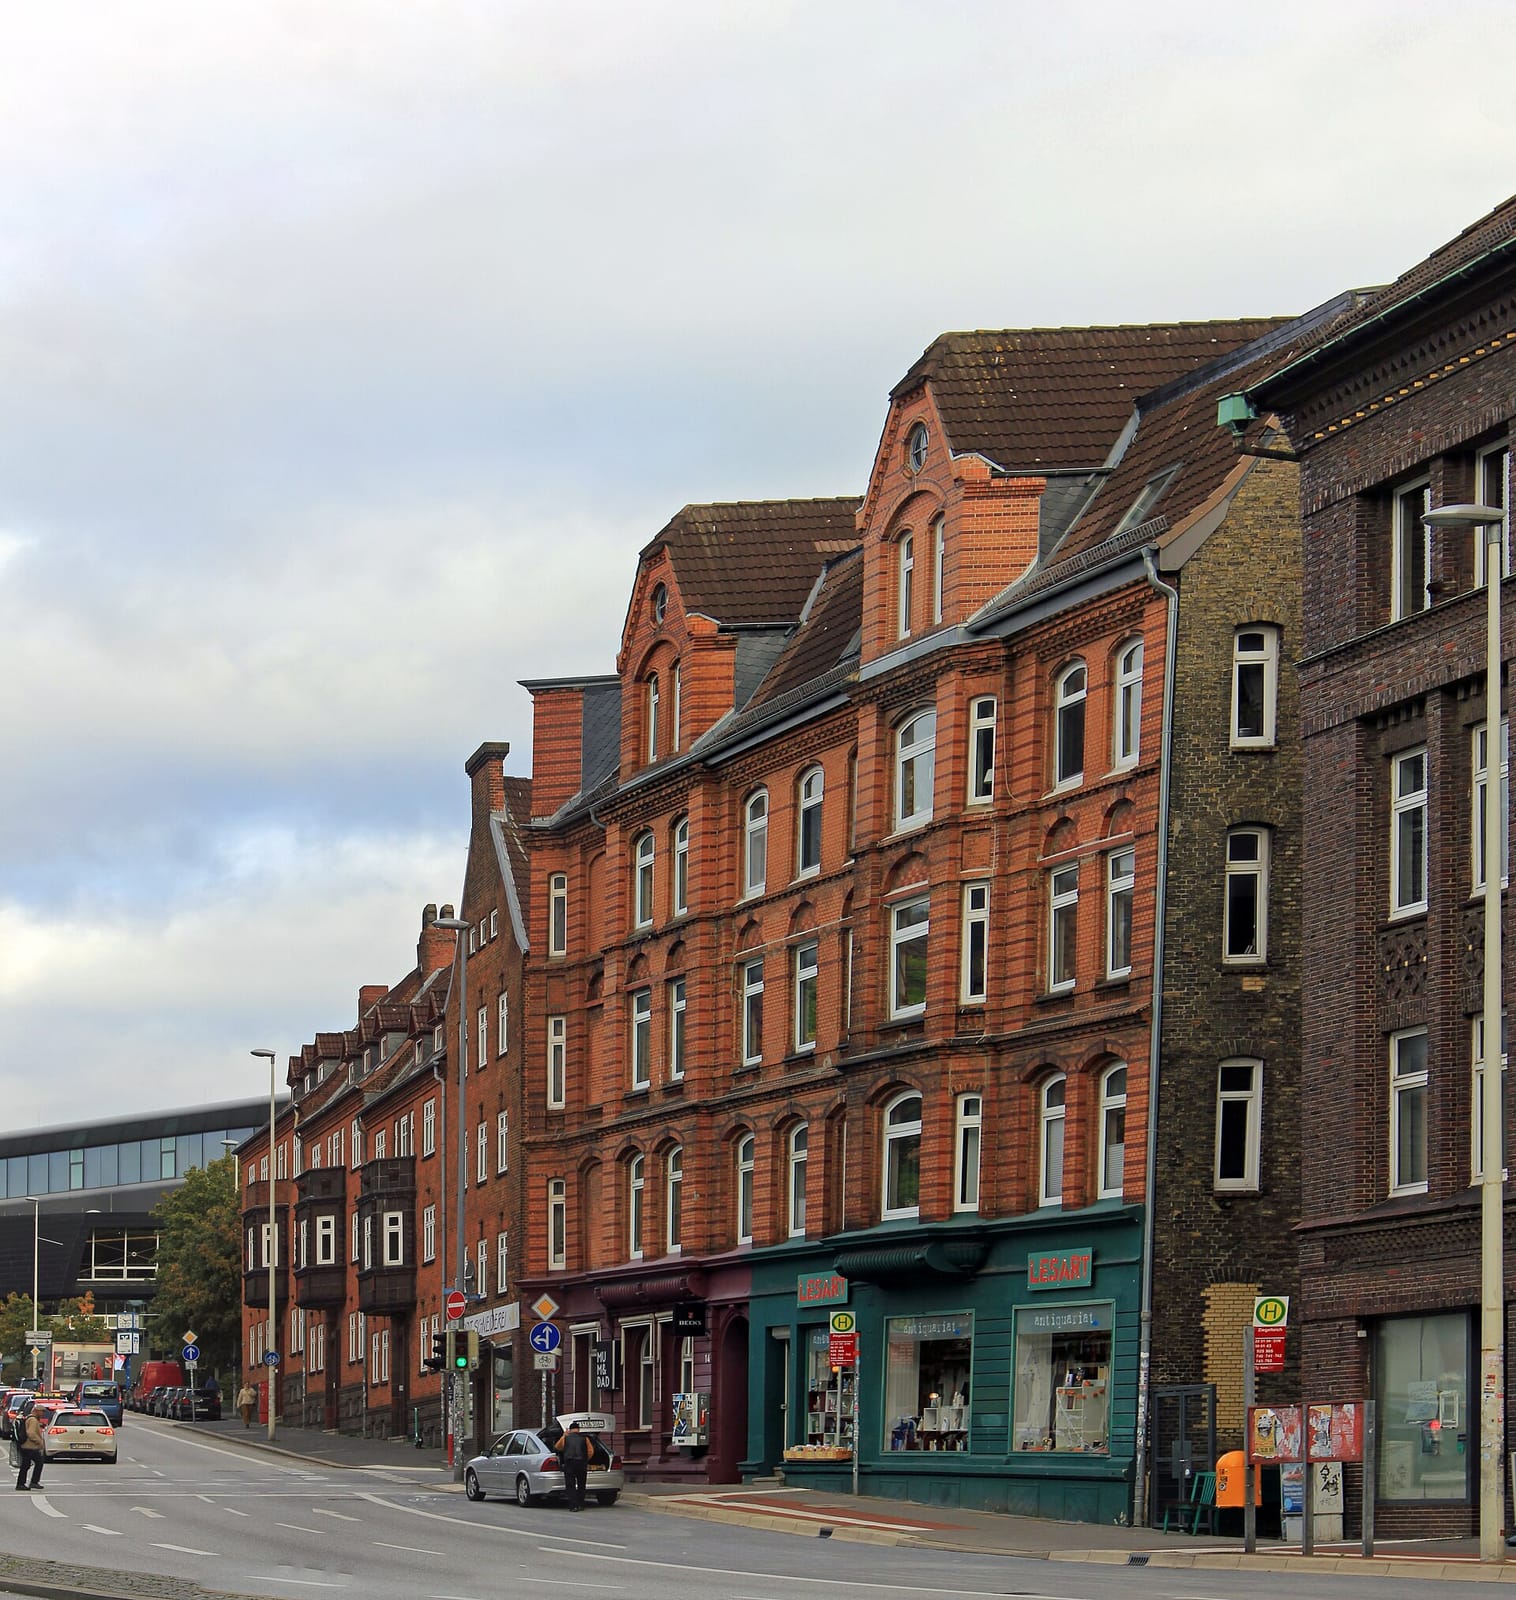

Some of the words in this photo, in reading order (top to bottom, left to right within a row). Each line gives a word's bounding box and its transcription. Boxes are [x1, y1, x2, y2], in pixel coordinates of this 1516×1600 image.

[1029, 1255, 1090, 1283] LESART
[799, 1276, 846, 1302] LESART
[1264, 1304, 1277, 1319] H
[838, 1317, 848, 1328] H
[1034, 1312, 1093, 1329] antiquariat
[903, 1321, 956, 1336] antiquariat
[597, 1376, 610, 1388] DAD
